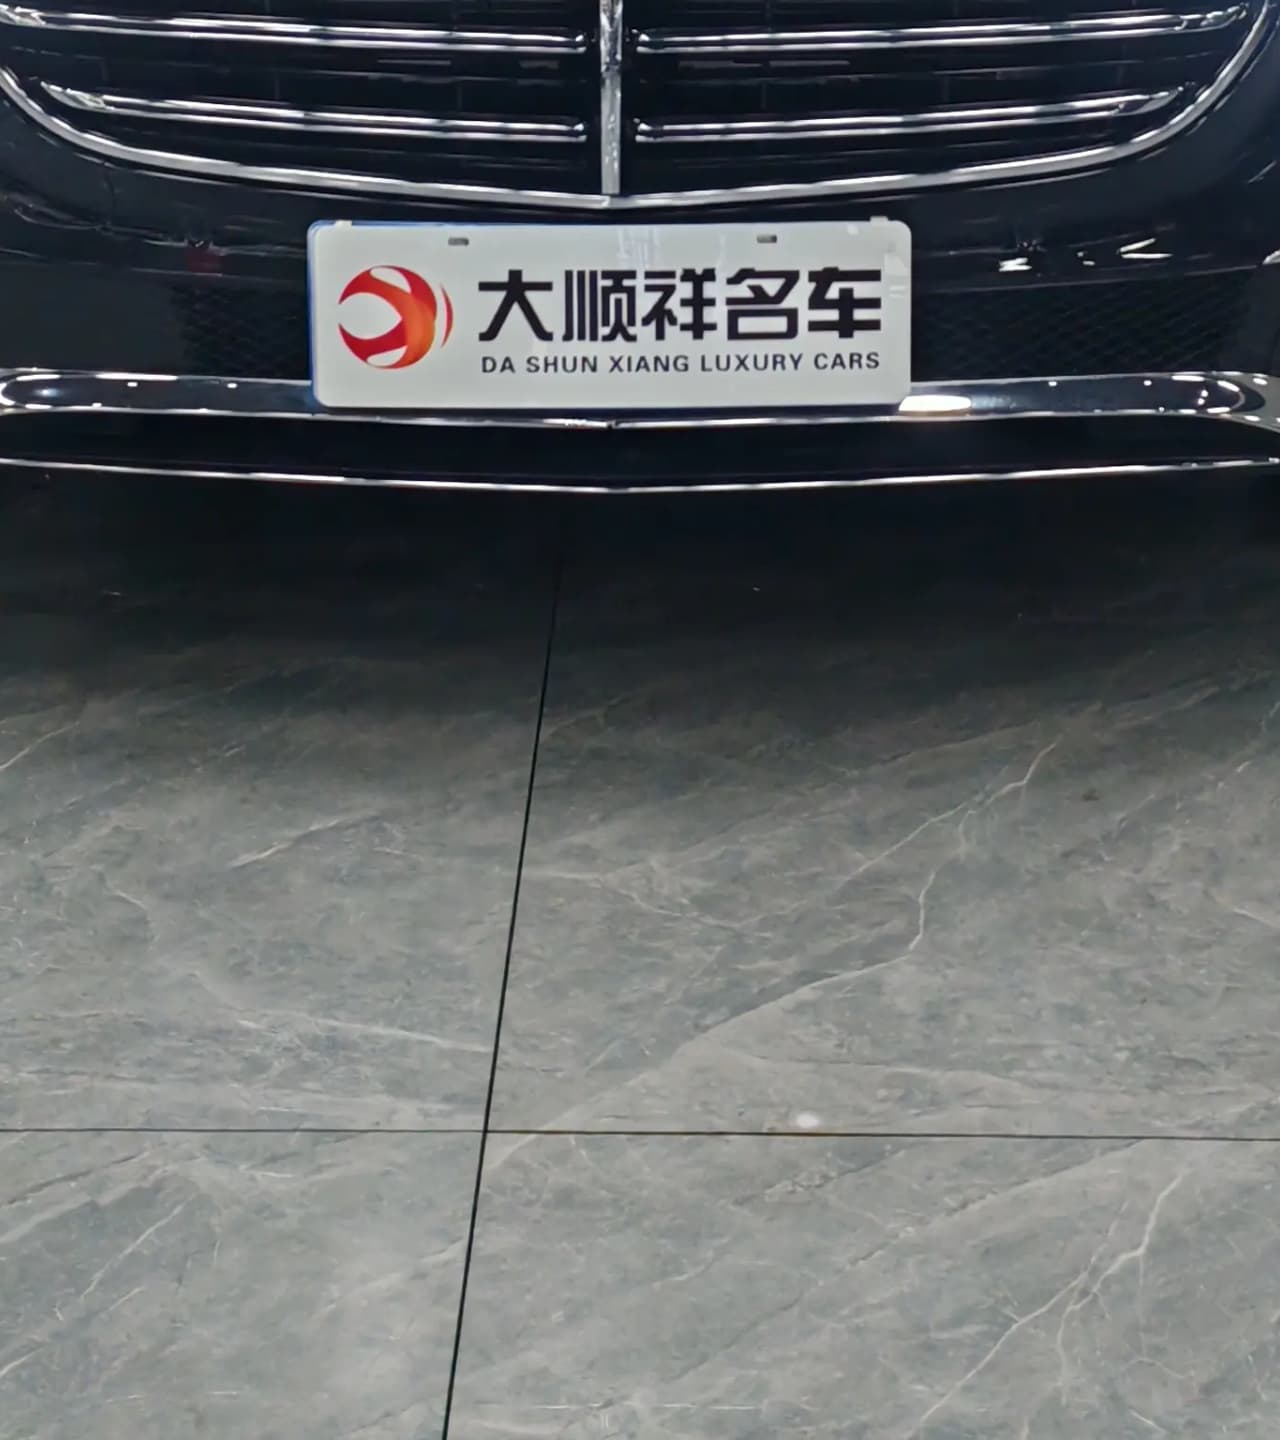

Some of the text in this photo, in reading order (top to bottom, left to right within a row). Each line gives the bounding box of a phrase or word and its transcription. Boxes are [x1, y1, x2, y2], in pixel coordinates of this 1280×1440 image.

[478, 267, 882, 342] 大顺祥名车
[481, 352, 881, 374] DA SHUN XIANG LUXURY CARS
